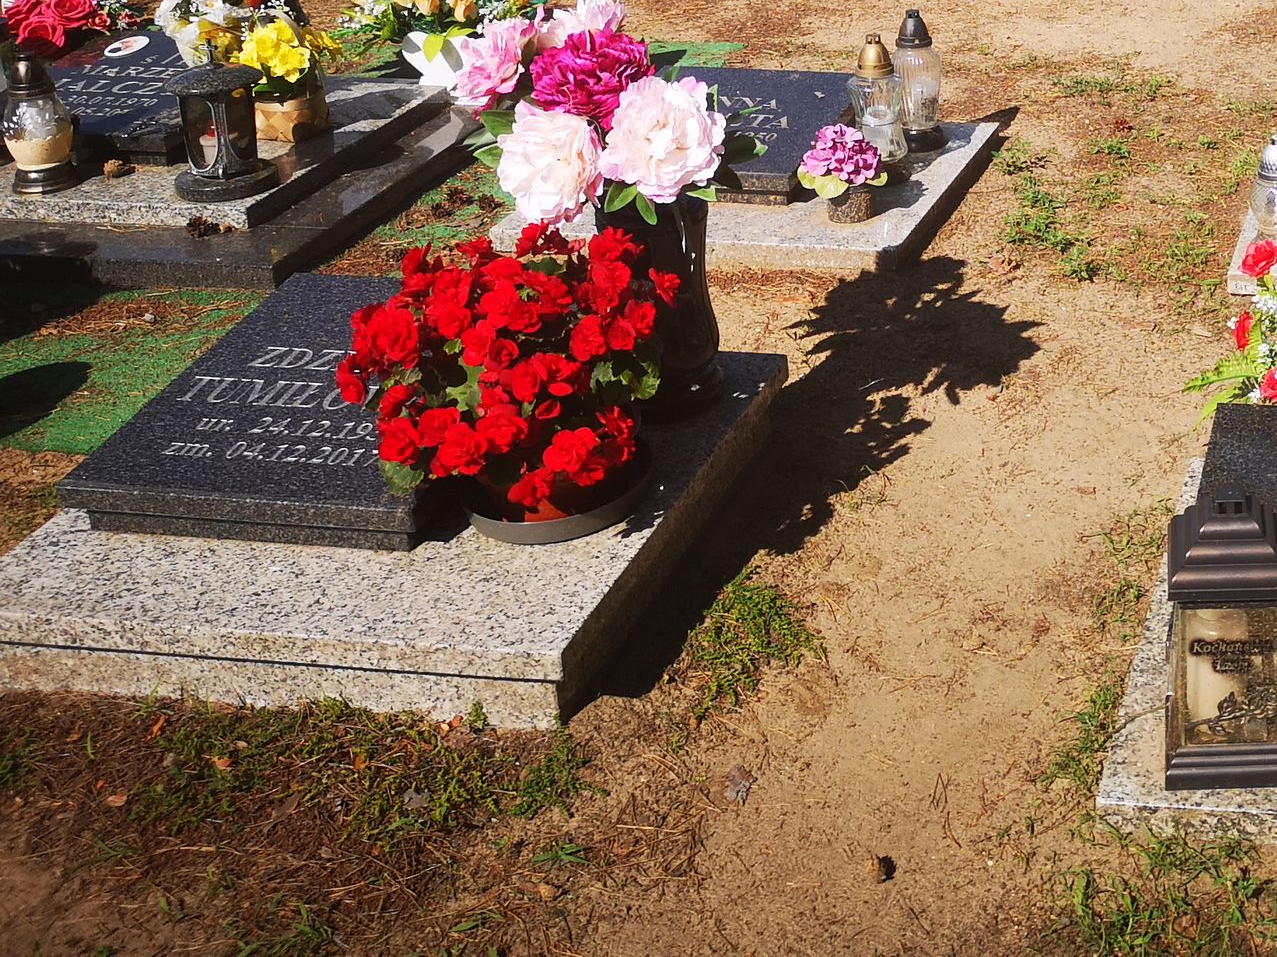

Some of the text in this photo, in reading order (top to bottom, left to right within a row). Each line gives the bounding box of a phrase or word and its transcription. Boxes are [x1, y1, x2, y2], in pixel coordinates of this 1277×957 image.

[69, 64, 188, 79] MARZE
[54, 78, 175, 95] ALCZ
[718, 95, 778, 110] NNA
[246, 345, 357, 371] ZDZ
[194, 415, 378, 441] ur. 24.12.19
[161, 440, 380, 467] zm. 04.12.2017
